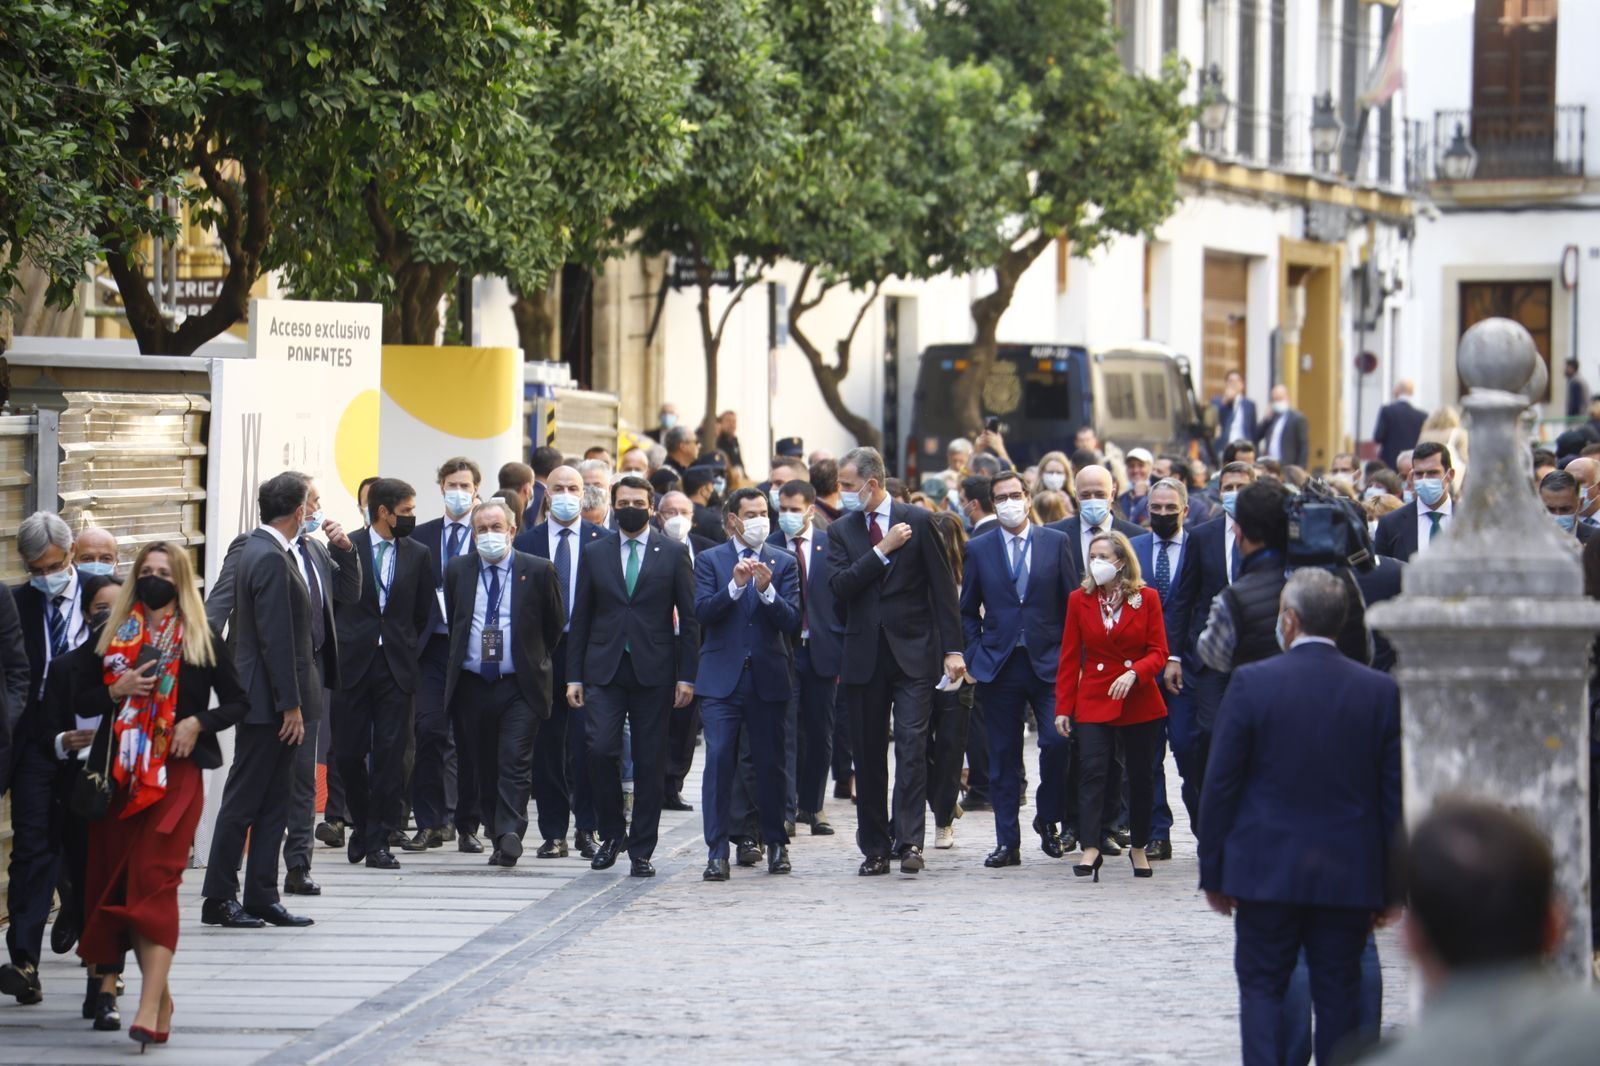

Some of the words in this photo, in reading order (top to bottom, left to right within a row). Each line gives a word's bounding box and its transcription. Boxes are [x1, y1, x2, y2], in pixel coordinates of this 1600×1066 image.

[269, 316, 312, 337] Acceso
[314, 319, 371, 340] exclusivo
[287, 345, 352, 367] PONENTES
